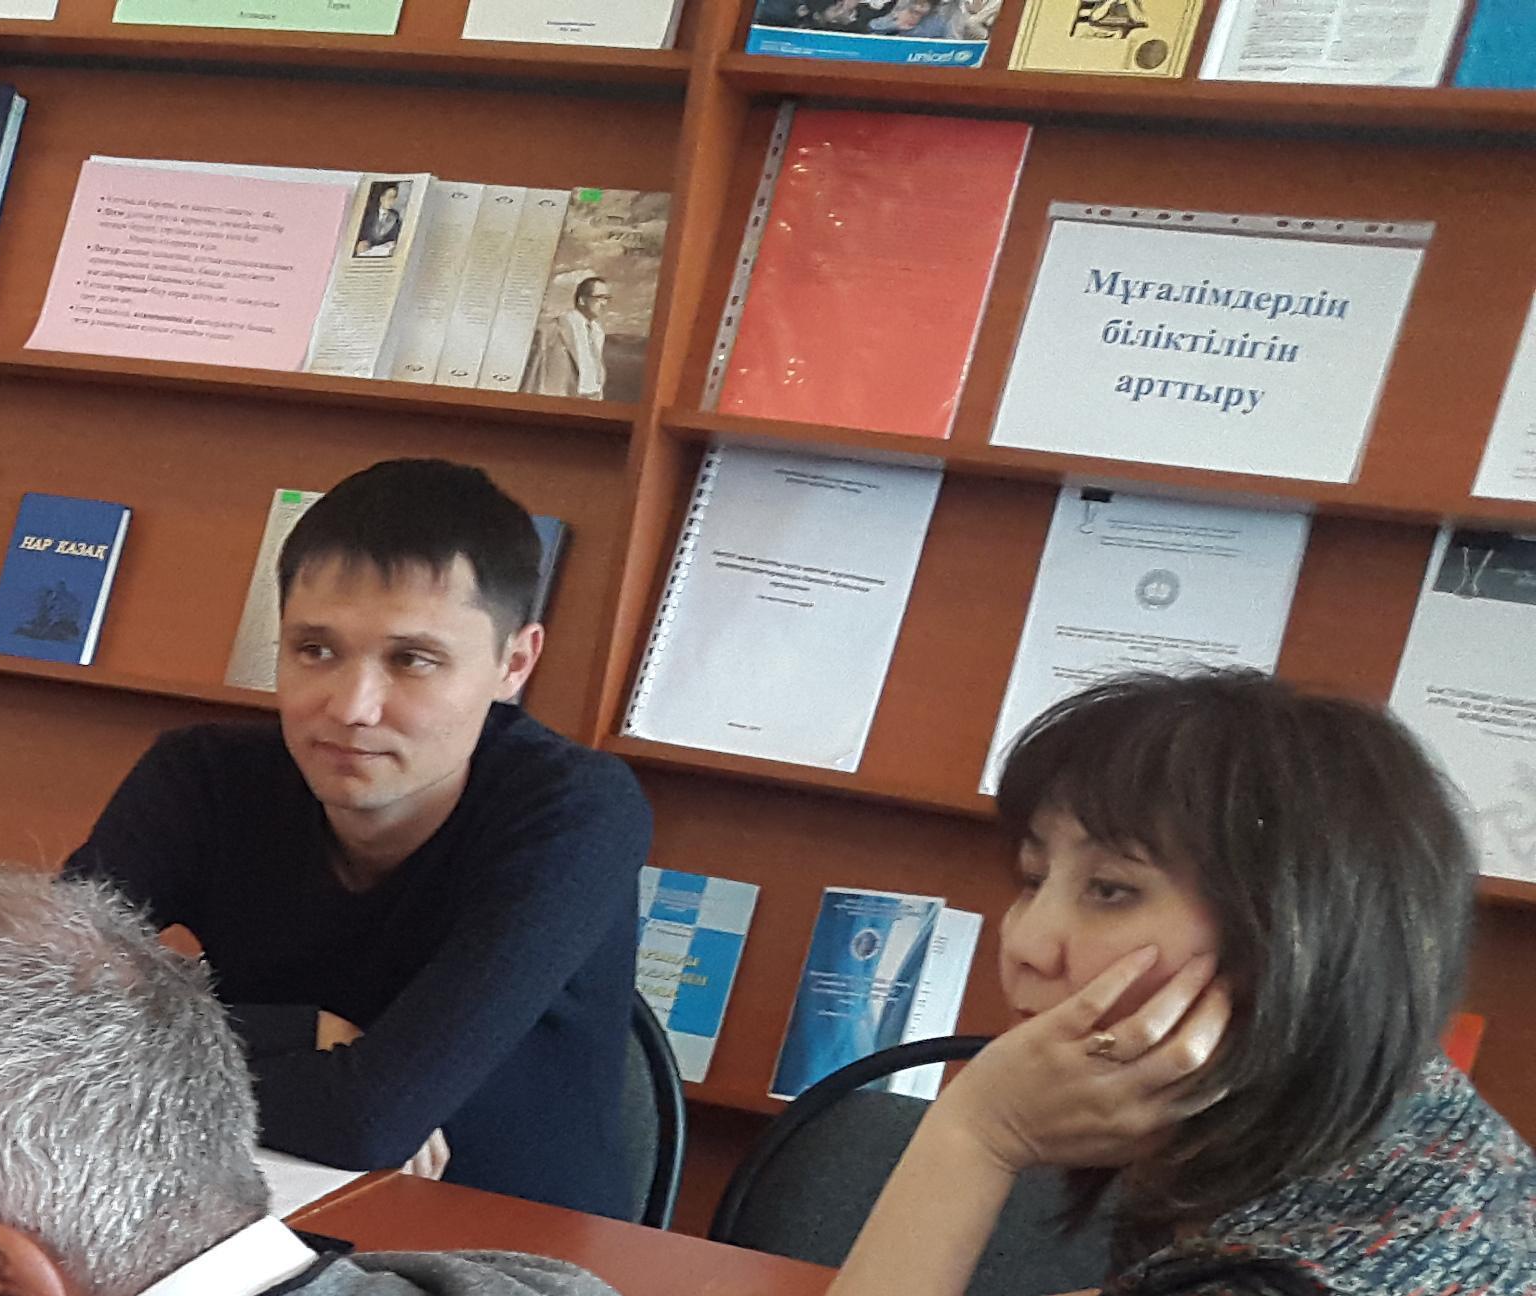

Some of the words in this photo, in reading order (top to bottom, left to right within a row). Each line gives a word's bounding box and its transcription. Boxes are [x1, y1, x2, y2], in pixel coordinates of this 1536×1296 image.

[1101, 319, 1299, 363] біліктілігін
[1114, 373, 1265, 415] арттыру
[19, 534, 55, 552] НАР
[55, 539, 109, 561] ҚАЗАҚ
